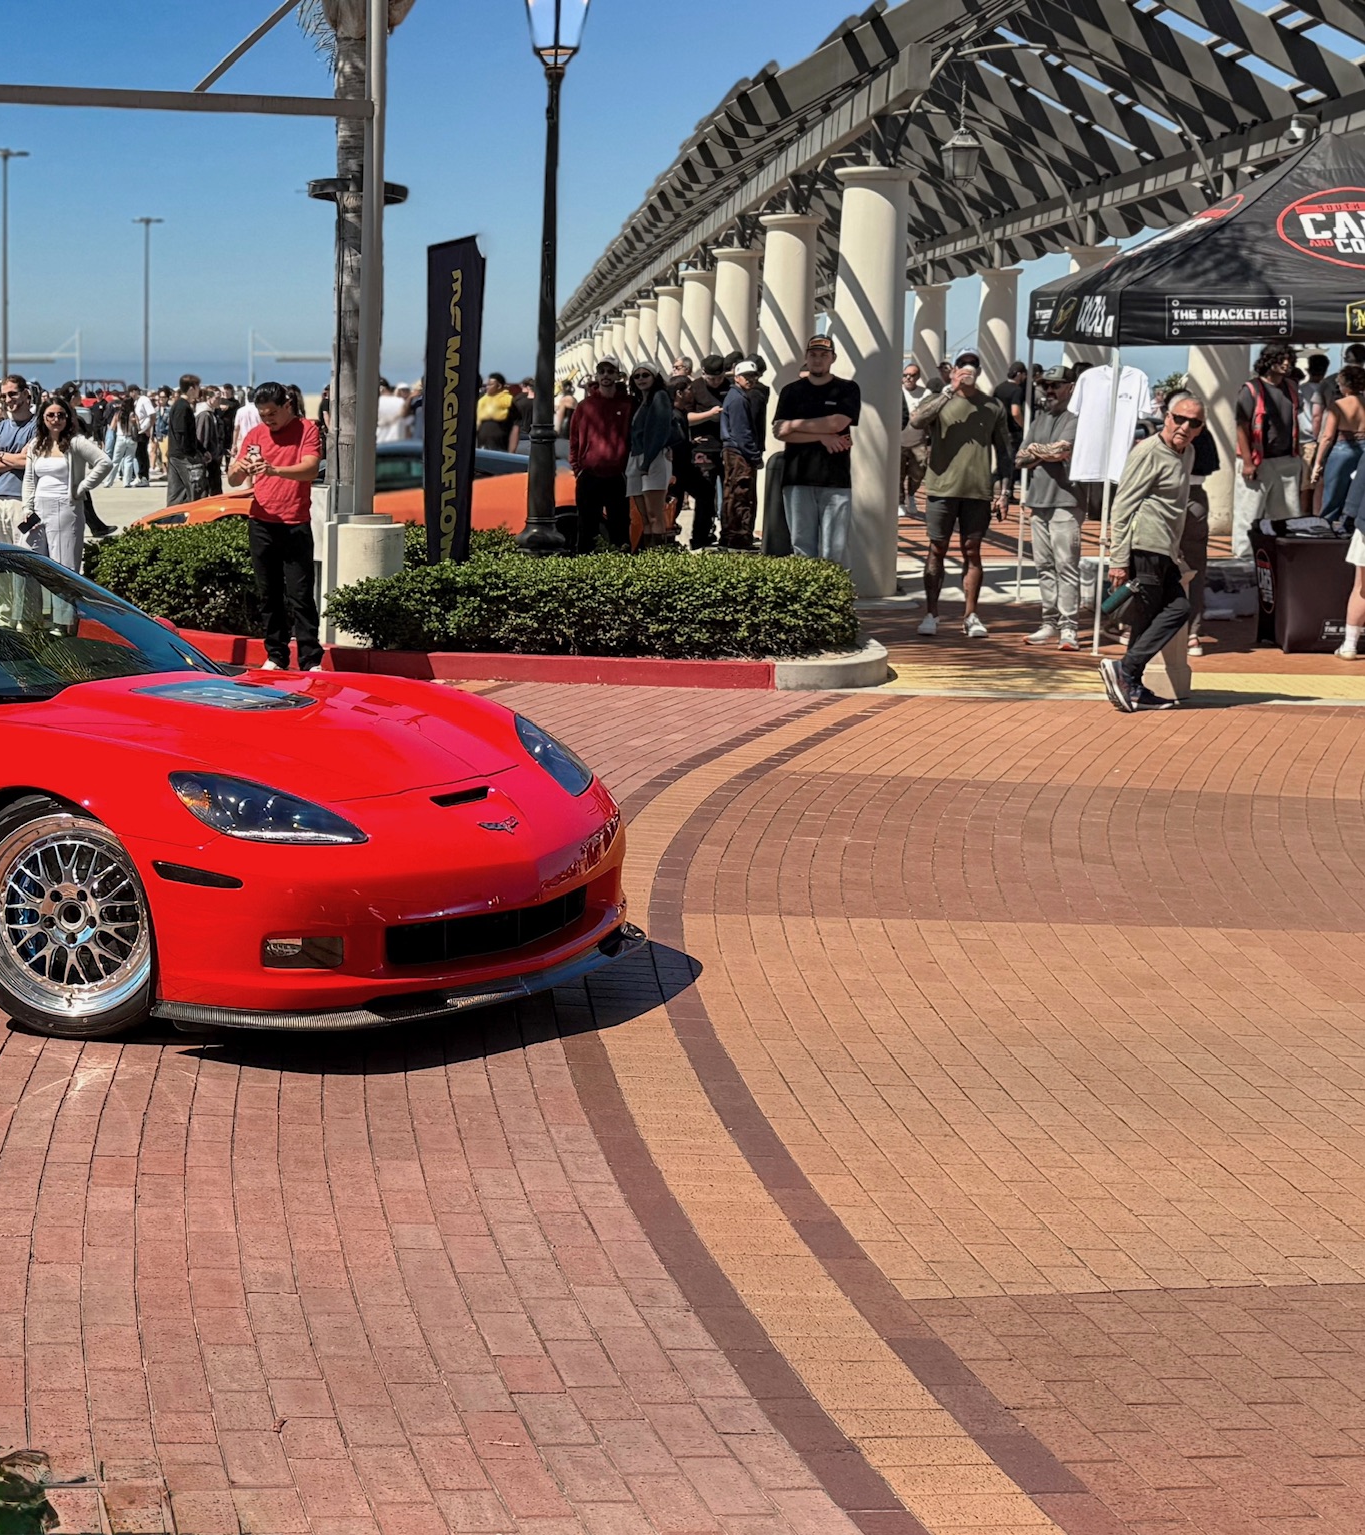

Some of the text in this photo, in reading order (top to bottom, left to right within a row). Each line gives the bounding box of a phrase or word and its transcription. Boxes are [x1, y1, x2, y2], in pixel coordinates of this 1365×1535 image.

[1309, 239, 1335, 247] AND
[1172, 308, 1287, 320] THE BRACKETEER
[439, 335, 462, 562] MAGNAFLOW
